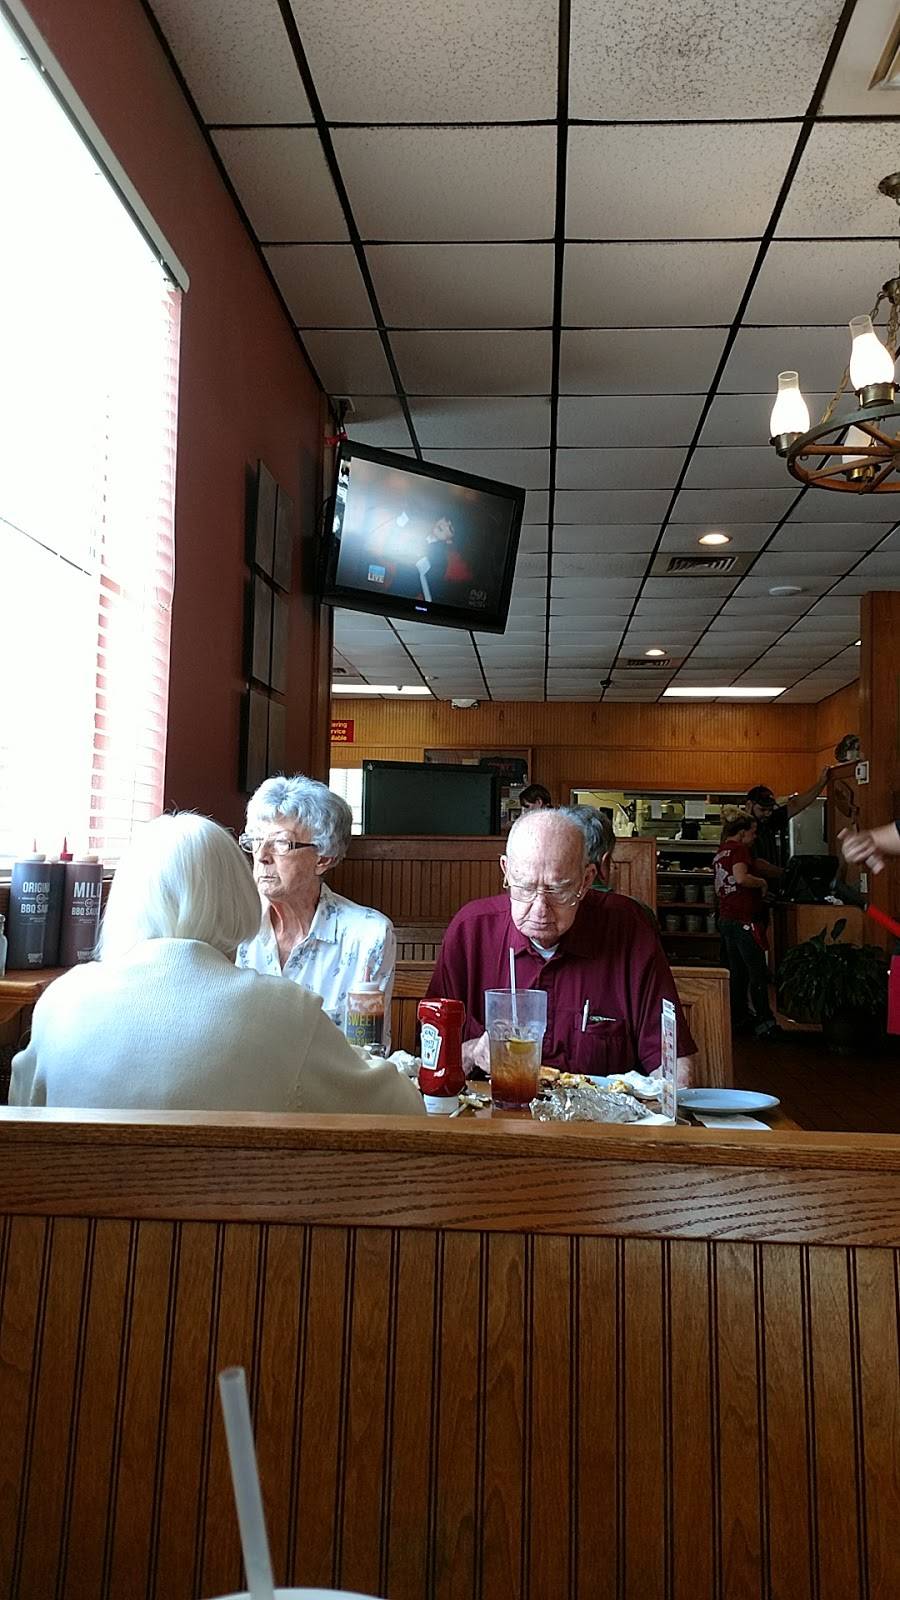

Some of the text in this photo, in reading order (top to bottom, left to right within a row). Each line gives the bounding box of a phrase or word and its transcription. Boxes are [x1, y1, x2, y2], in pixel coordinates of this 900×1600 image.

[367, 572, 385, 584] LIVE
[20, 903, 36, 914] BBQ
[71, 907, 85, 916] BBQ
[348, 1012, 376, 1026] SWEET
